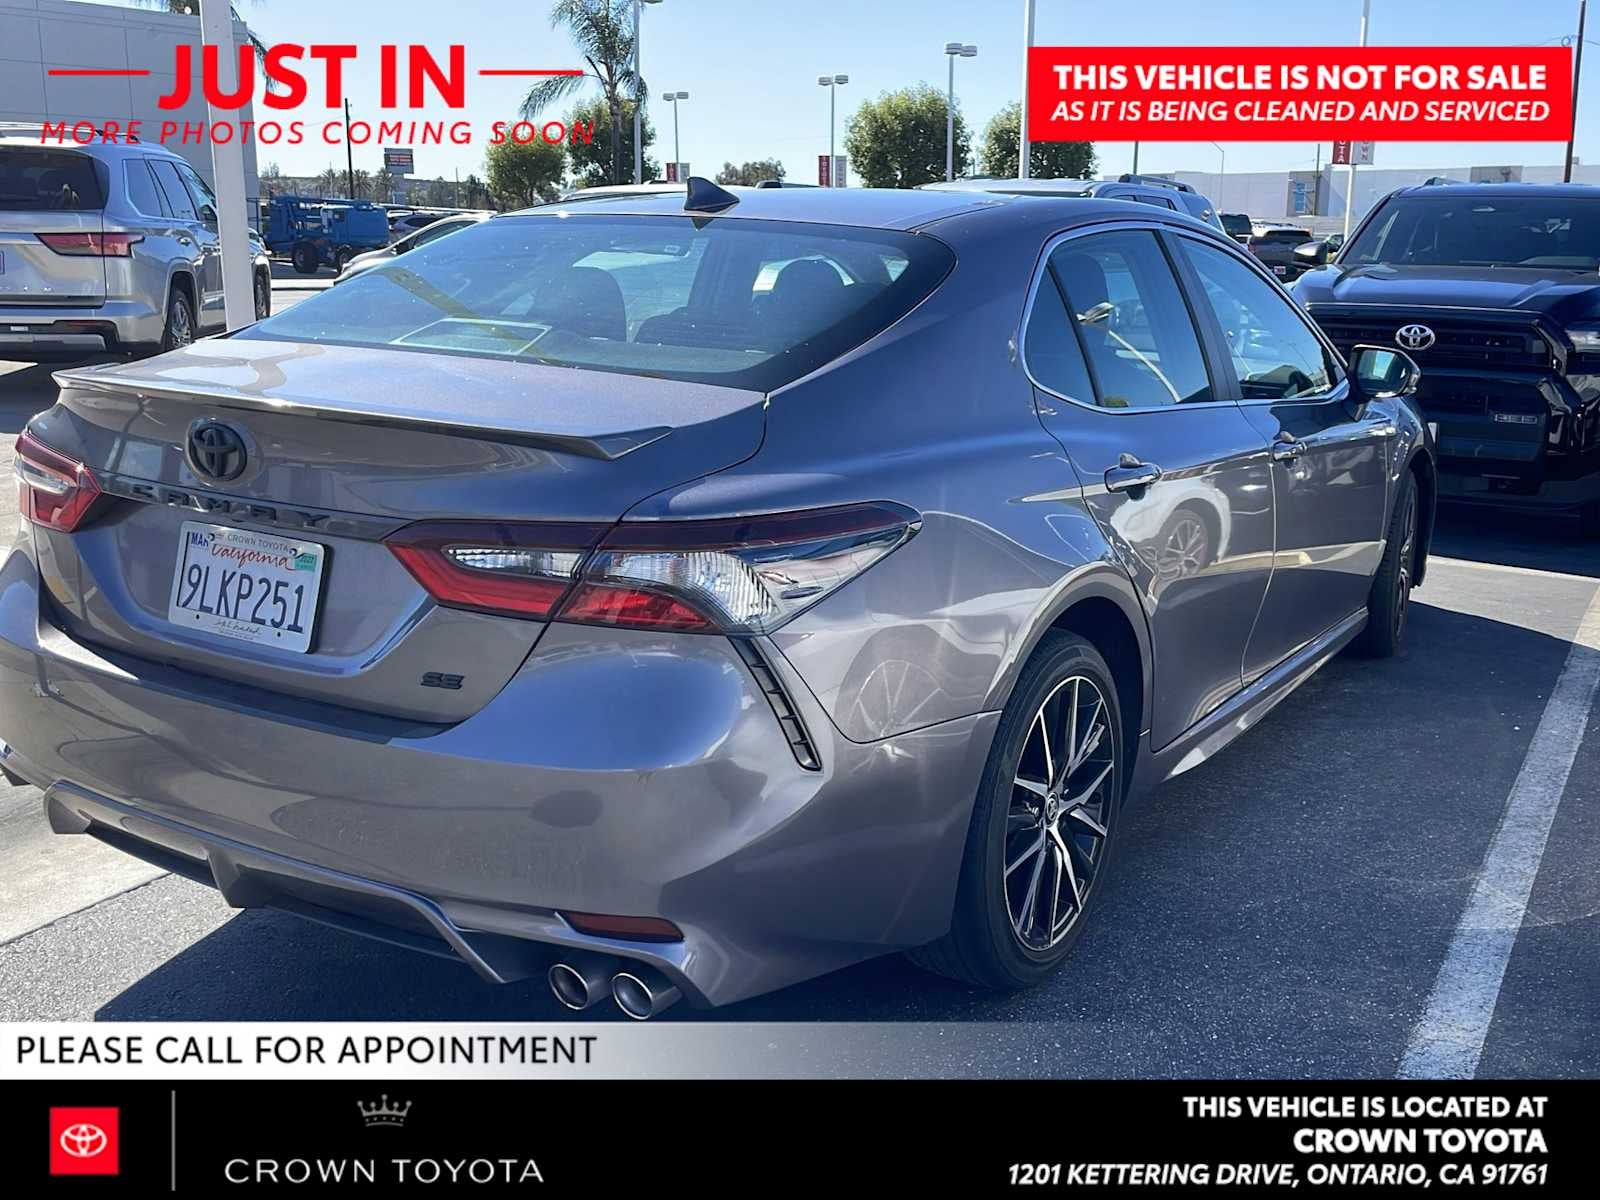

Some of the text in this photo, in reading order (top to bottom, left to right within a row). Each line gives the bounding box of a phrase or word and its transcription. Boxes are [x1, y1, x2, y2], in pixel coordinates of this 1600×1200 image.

[227, 533, 289, 552] CROWN TOYOTA
[211, 543, 296, 571] California
[182, 563, 305, 634] 9LKP251
[420, 671, 465, 690] SE
